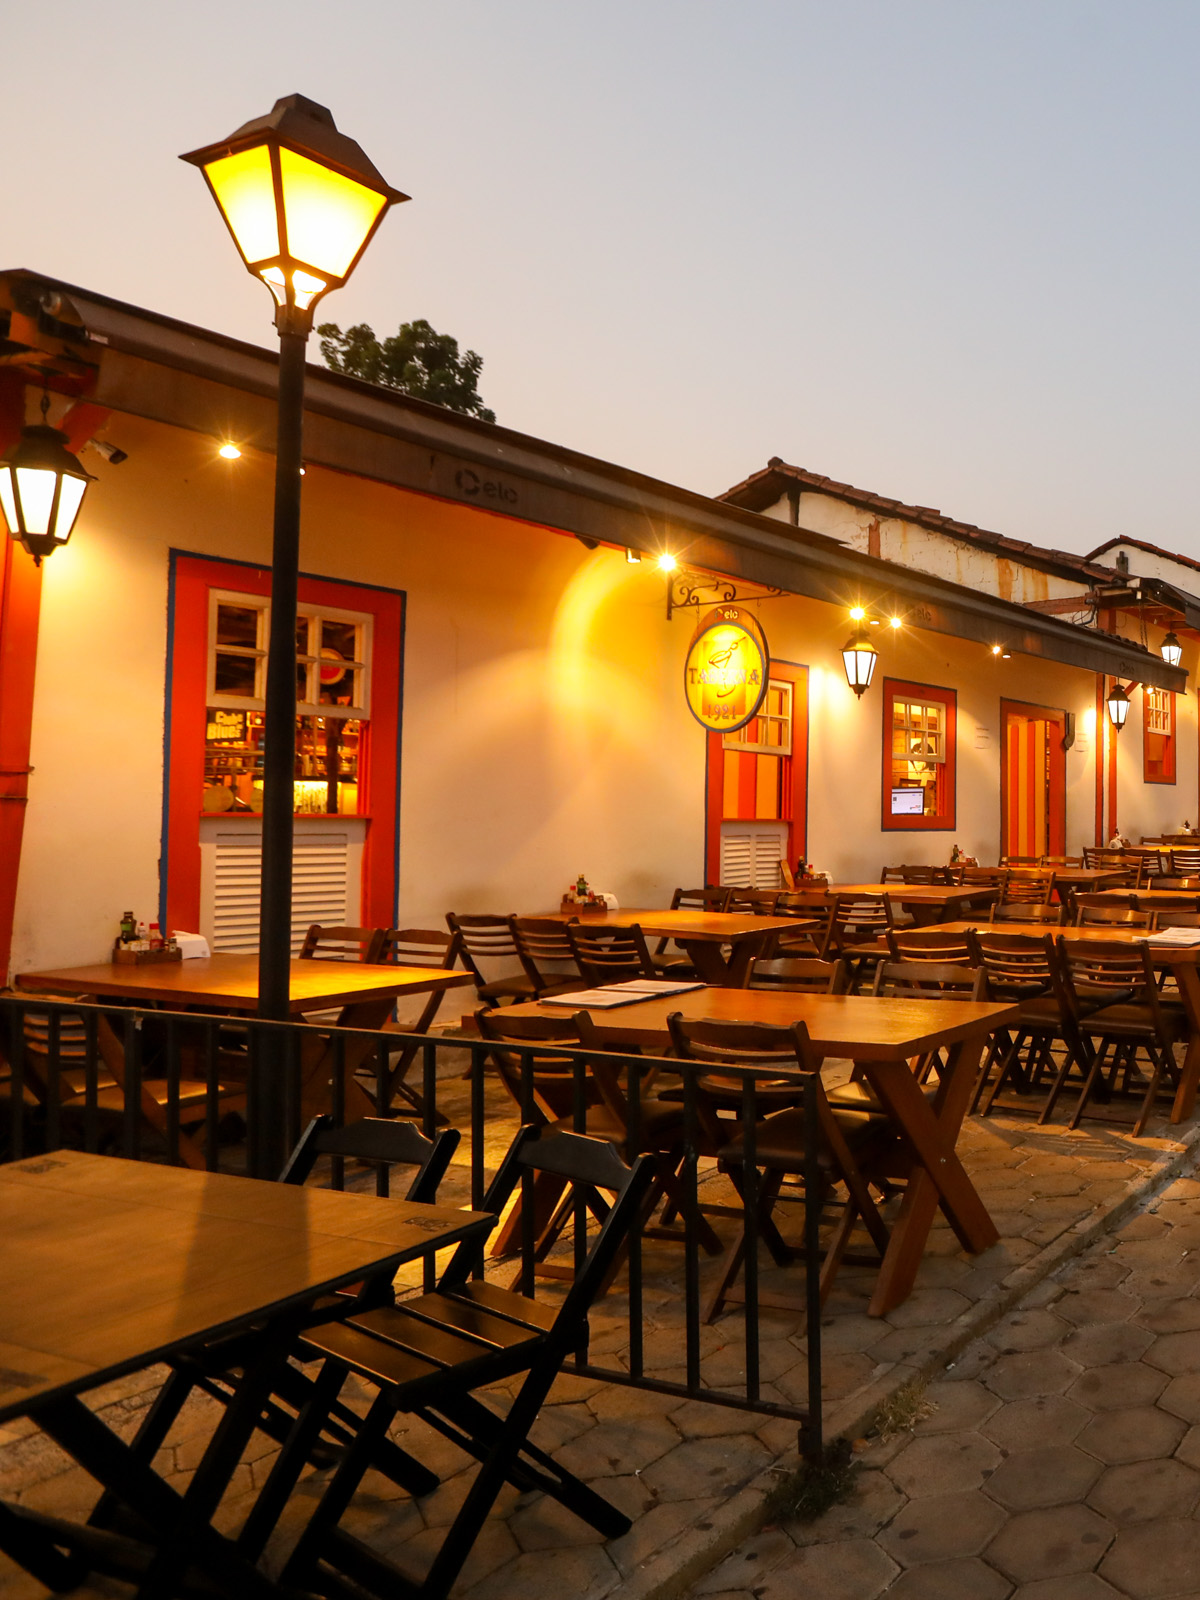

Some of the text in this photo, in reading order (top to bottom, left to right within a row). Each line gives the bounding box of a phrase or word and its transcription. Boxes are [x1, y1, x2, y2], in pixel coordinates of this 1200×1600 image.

[688, 667, 761, 686] TABERNA
[707, 704, 737, 721] 1921
[206, 722, 242, 740] Blues
